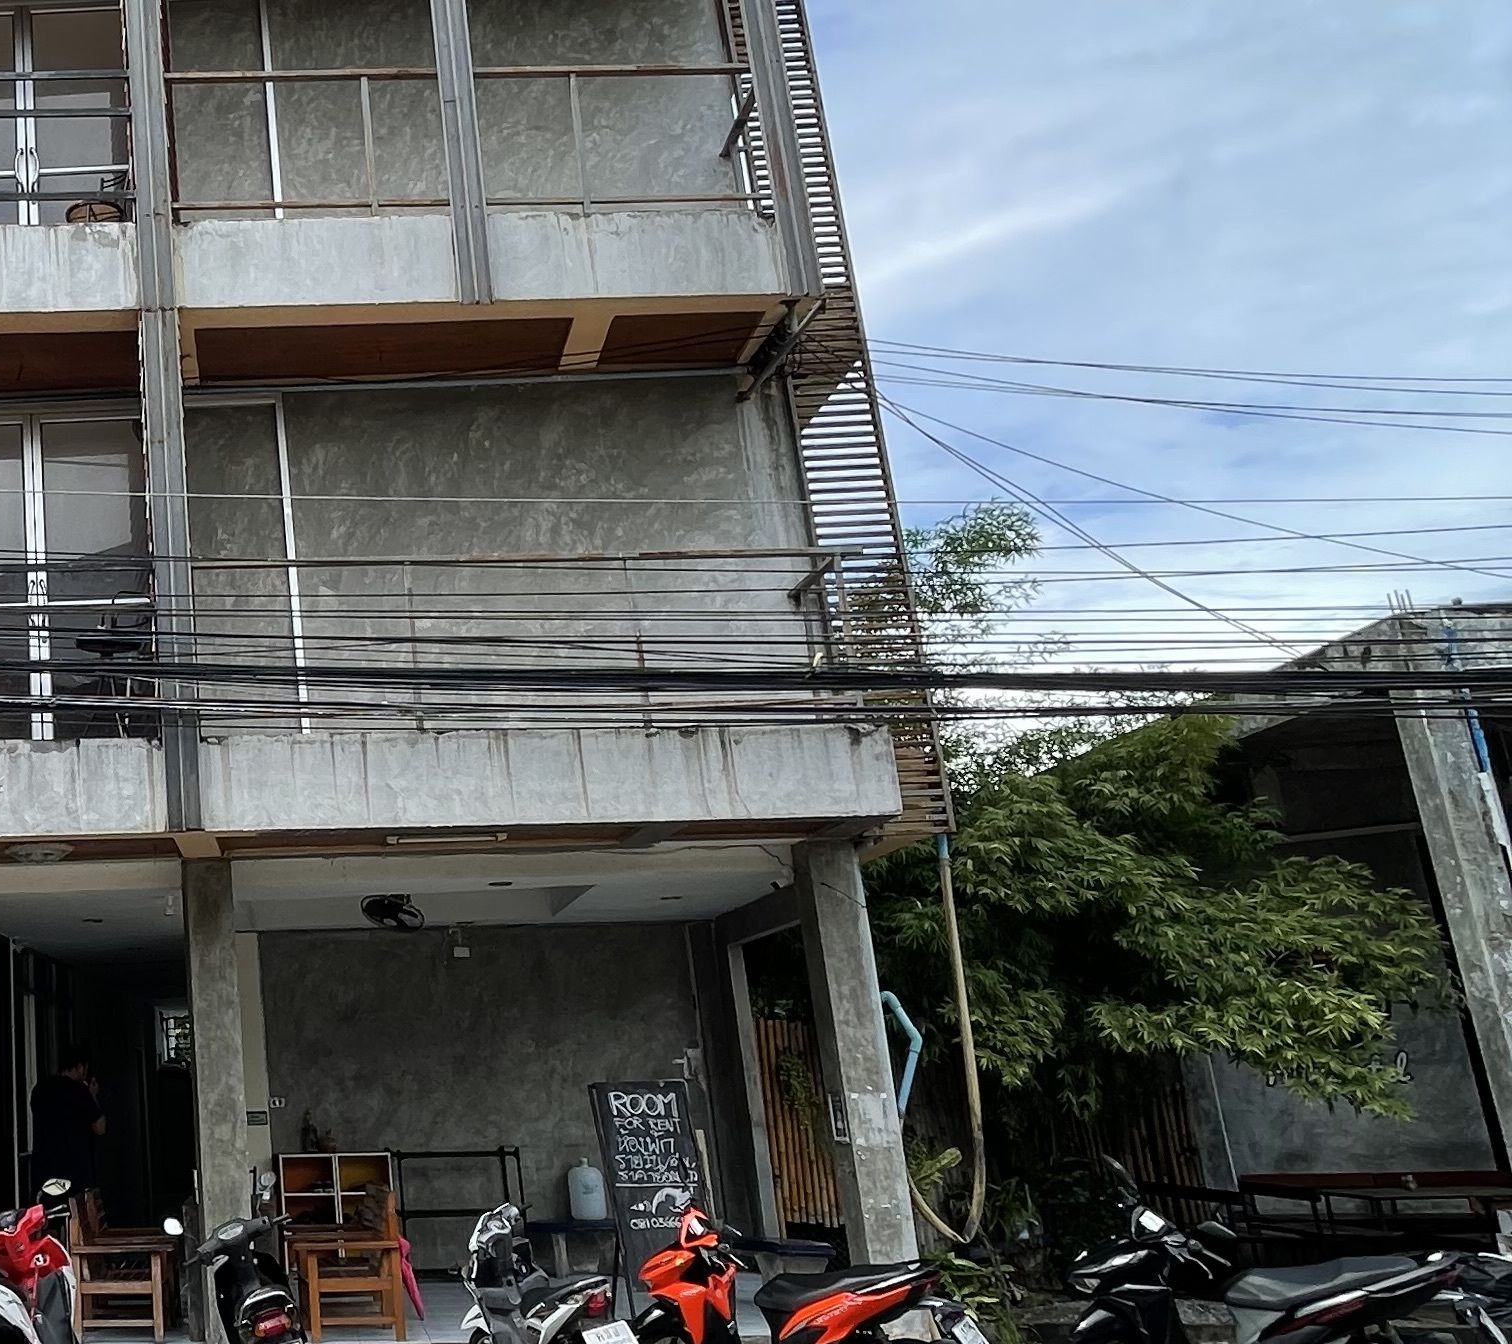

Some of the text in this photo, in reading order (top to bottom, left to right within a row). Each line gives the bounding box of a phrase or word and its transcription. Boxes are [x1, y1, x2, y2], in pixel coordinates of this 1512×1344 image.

[607, 1091, 679, 1118] ROOM
[613, 1116, 681, 1134] FOR RENT
